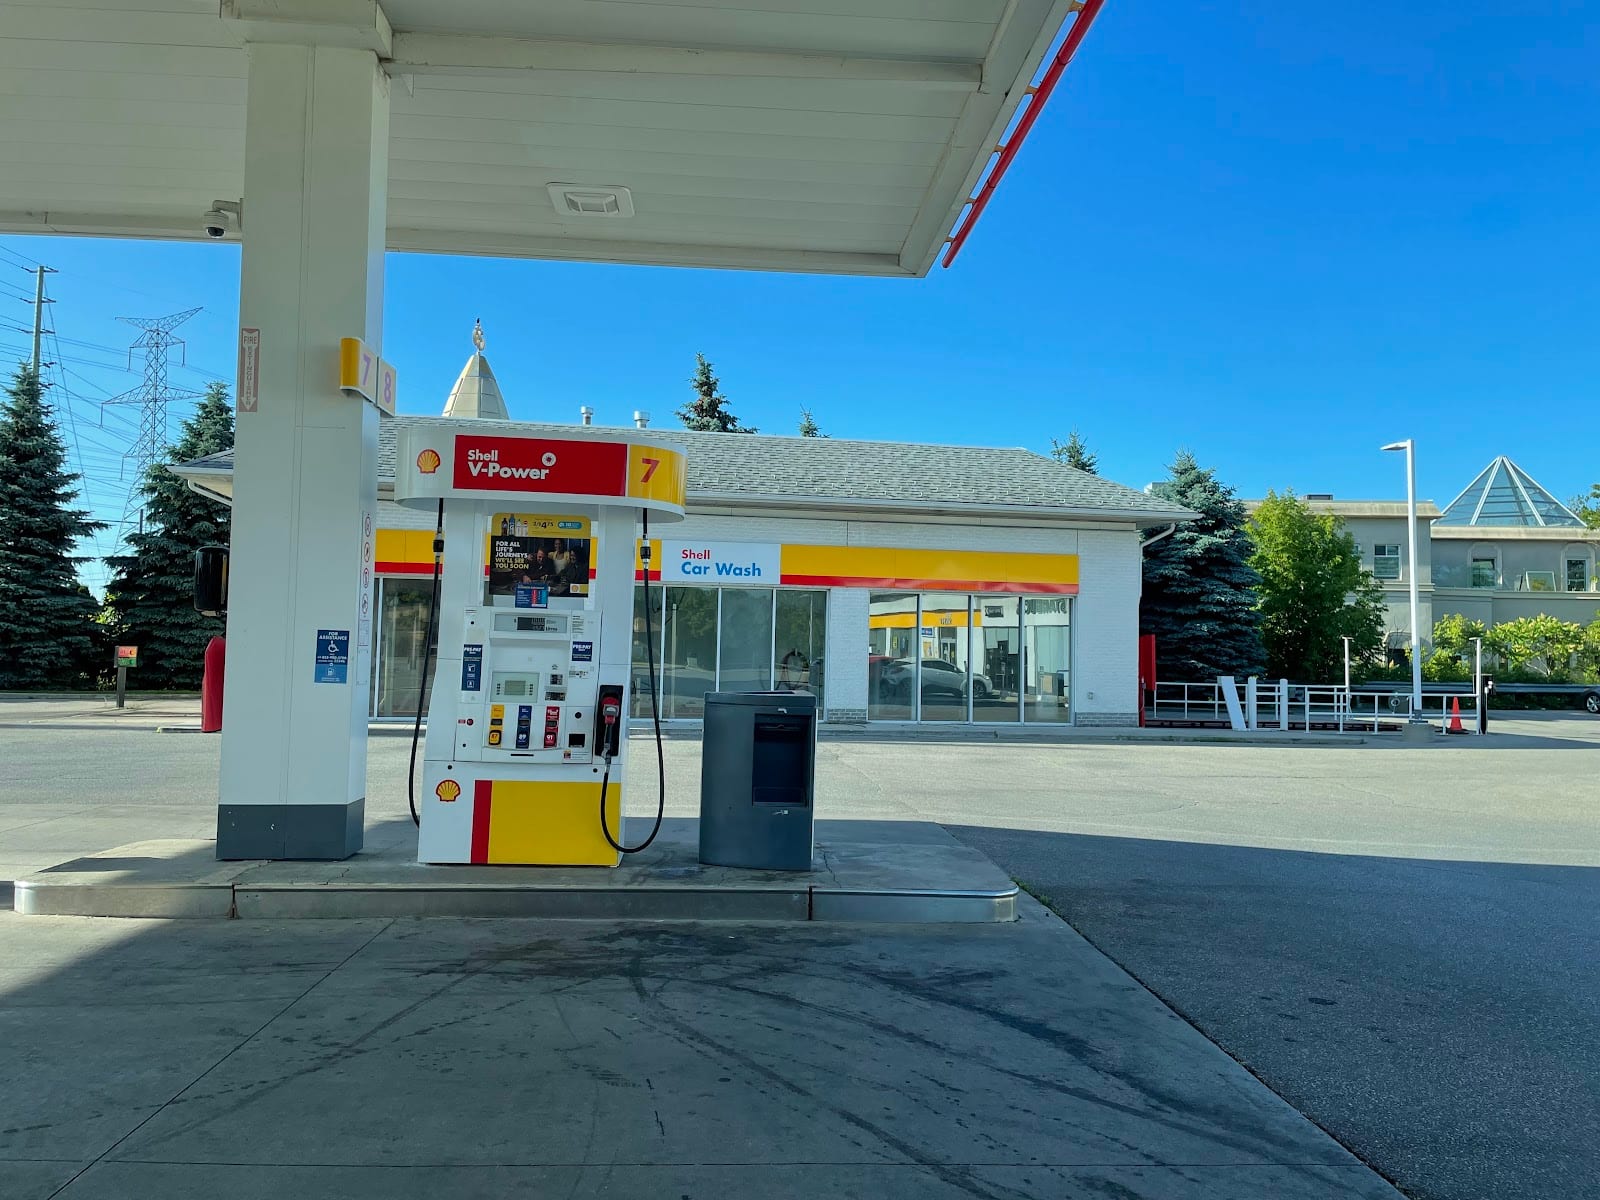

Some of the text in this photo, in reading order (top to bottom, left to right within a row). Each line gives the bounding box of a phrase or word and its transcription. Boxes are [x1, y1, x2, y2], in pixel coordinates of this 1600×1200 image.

[243, 335, 258, 345] FIRE
[363, 353, 371, 386] 7
[384, 371, 391, 404] 8
[467, 448, 498, 461] Shell
[467, 461, 549, 479] V-Power
[640, 457, 660, 483] 7
[681, 549, 711, 560] Shell
[681, 561, 762, 577] Car Wash
